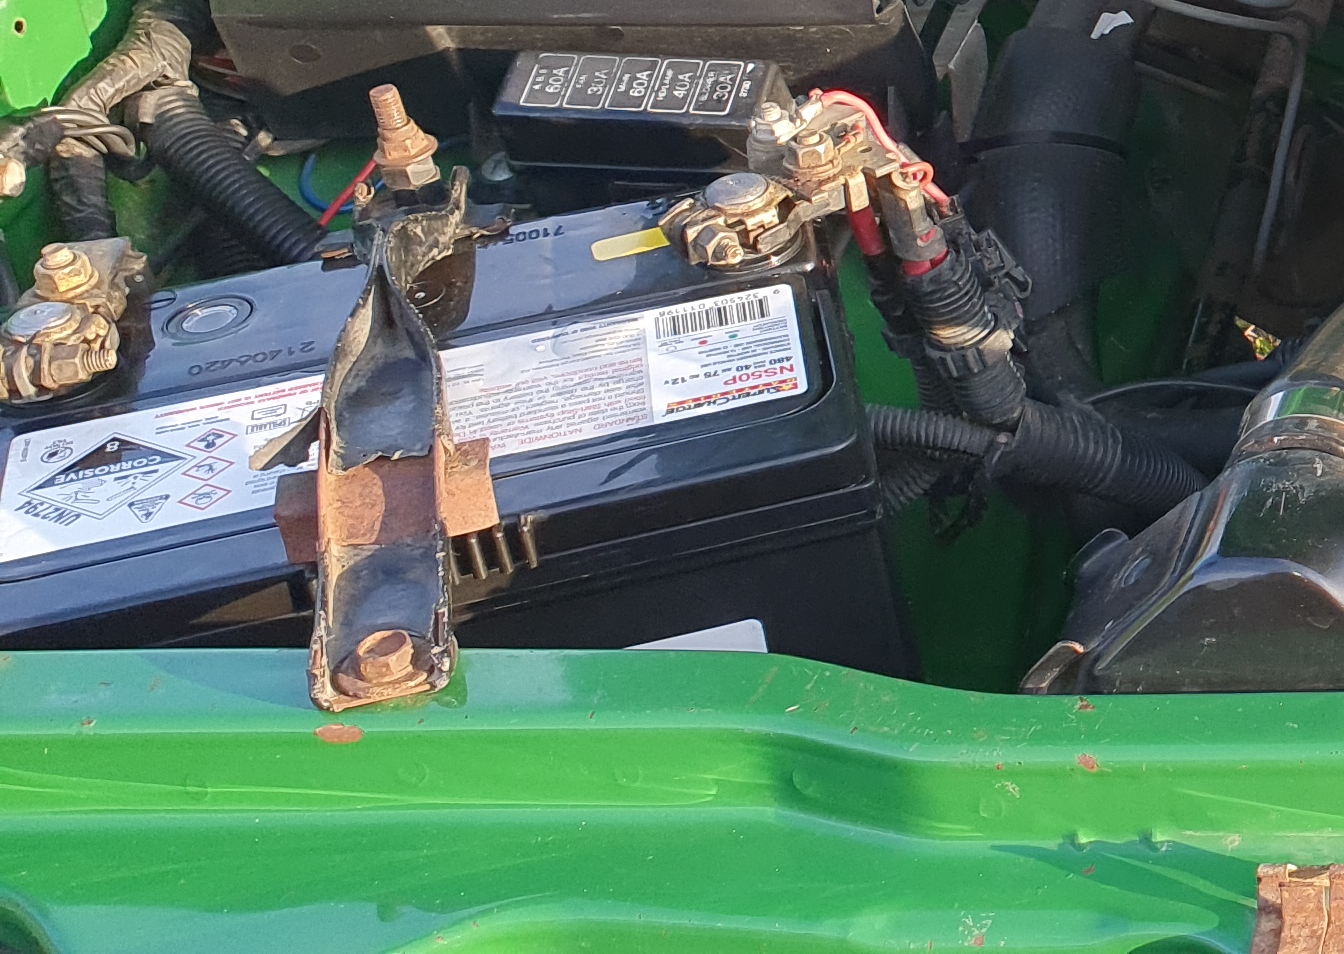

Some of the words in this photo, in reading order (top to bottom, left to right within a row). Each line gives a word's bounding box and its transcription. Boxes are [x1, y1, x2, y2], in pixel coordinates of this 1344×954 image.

[545, 67, 569, 93] 60A
[587, 69, 609, 94] 30A
[630, 71, 653, 96] 60A
[673, 72, 694, 98] 40A
[713, 74, 736, 101] 30A
[734, 363, 752, 372] 40
[768, 355, 793, 365] 480
[670, 375, 687, 385] 12
[703, 369, 719, 378] 75
[722, 363, 794, 386] NS50P
[105, 439, 121, 453] 8
[53, 453, 159, 484] CORROSIVE
[13, 500, 81, 525] UN2794
